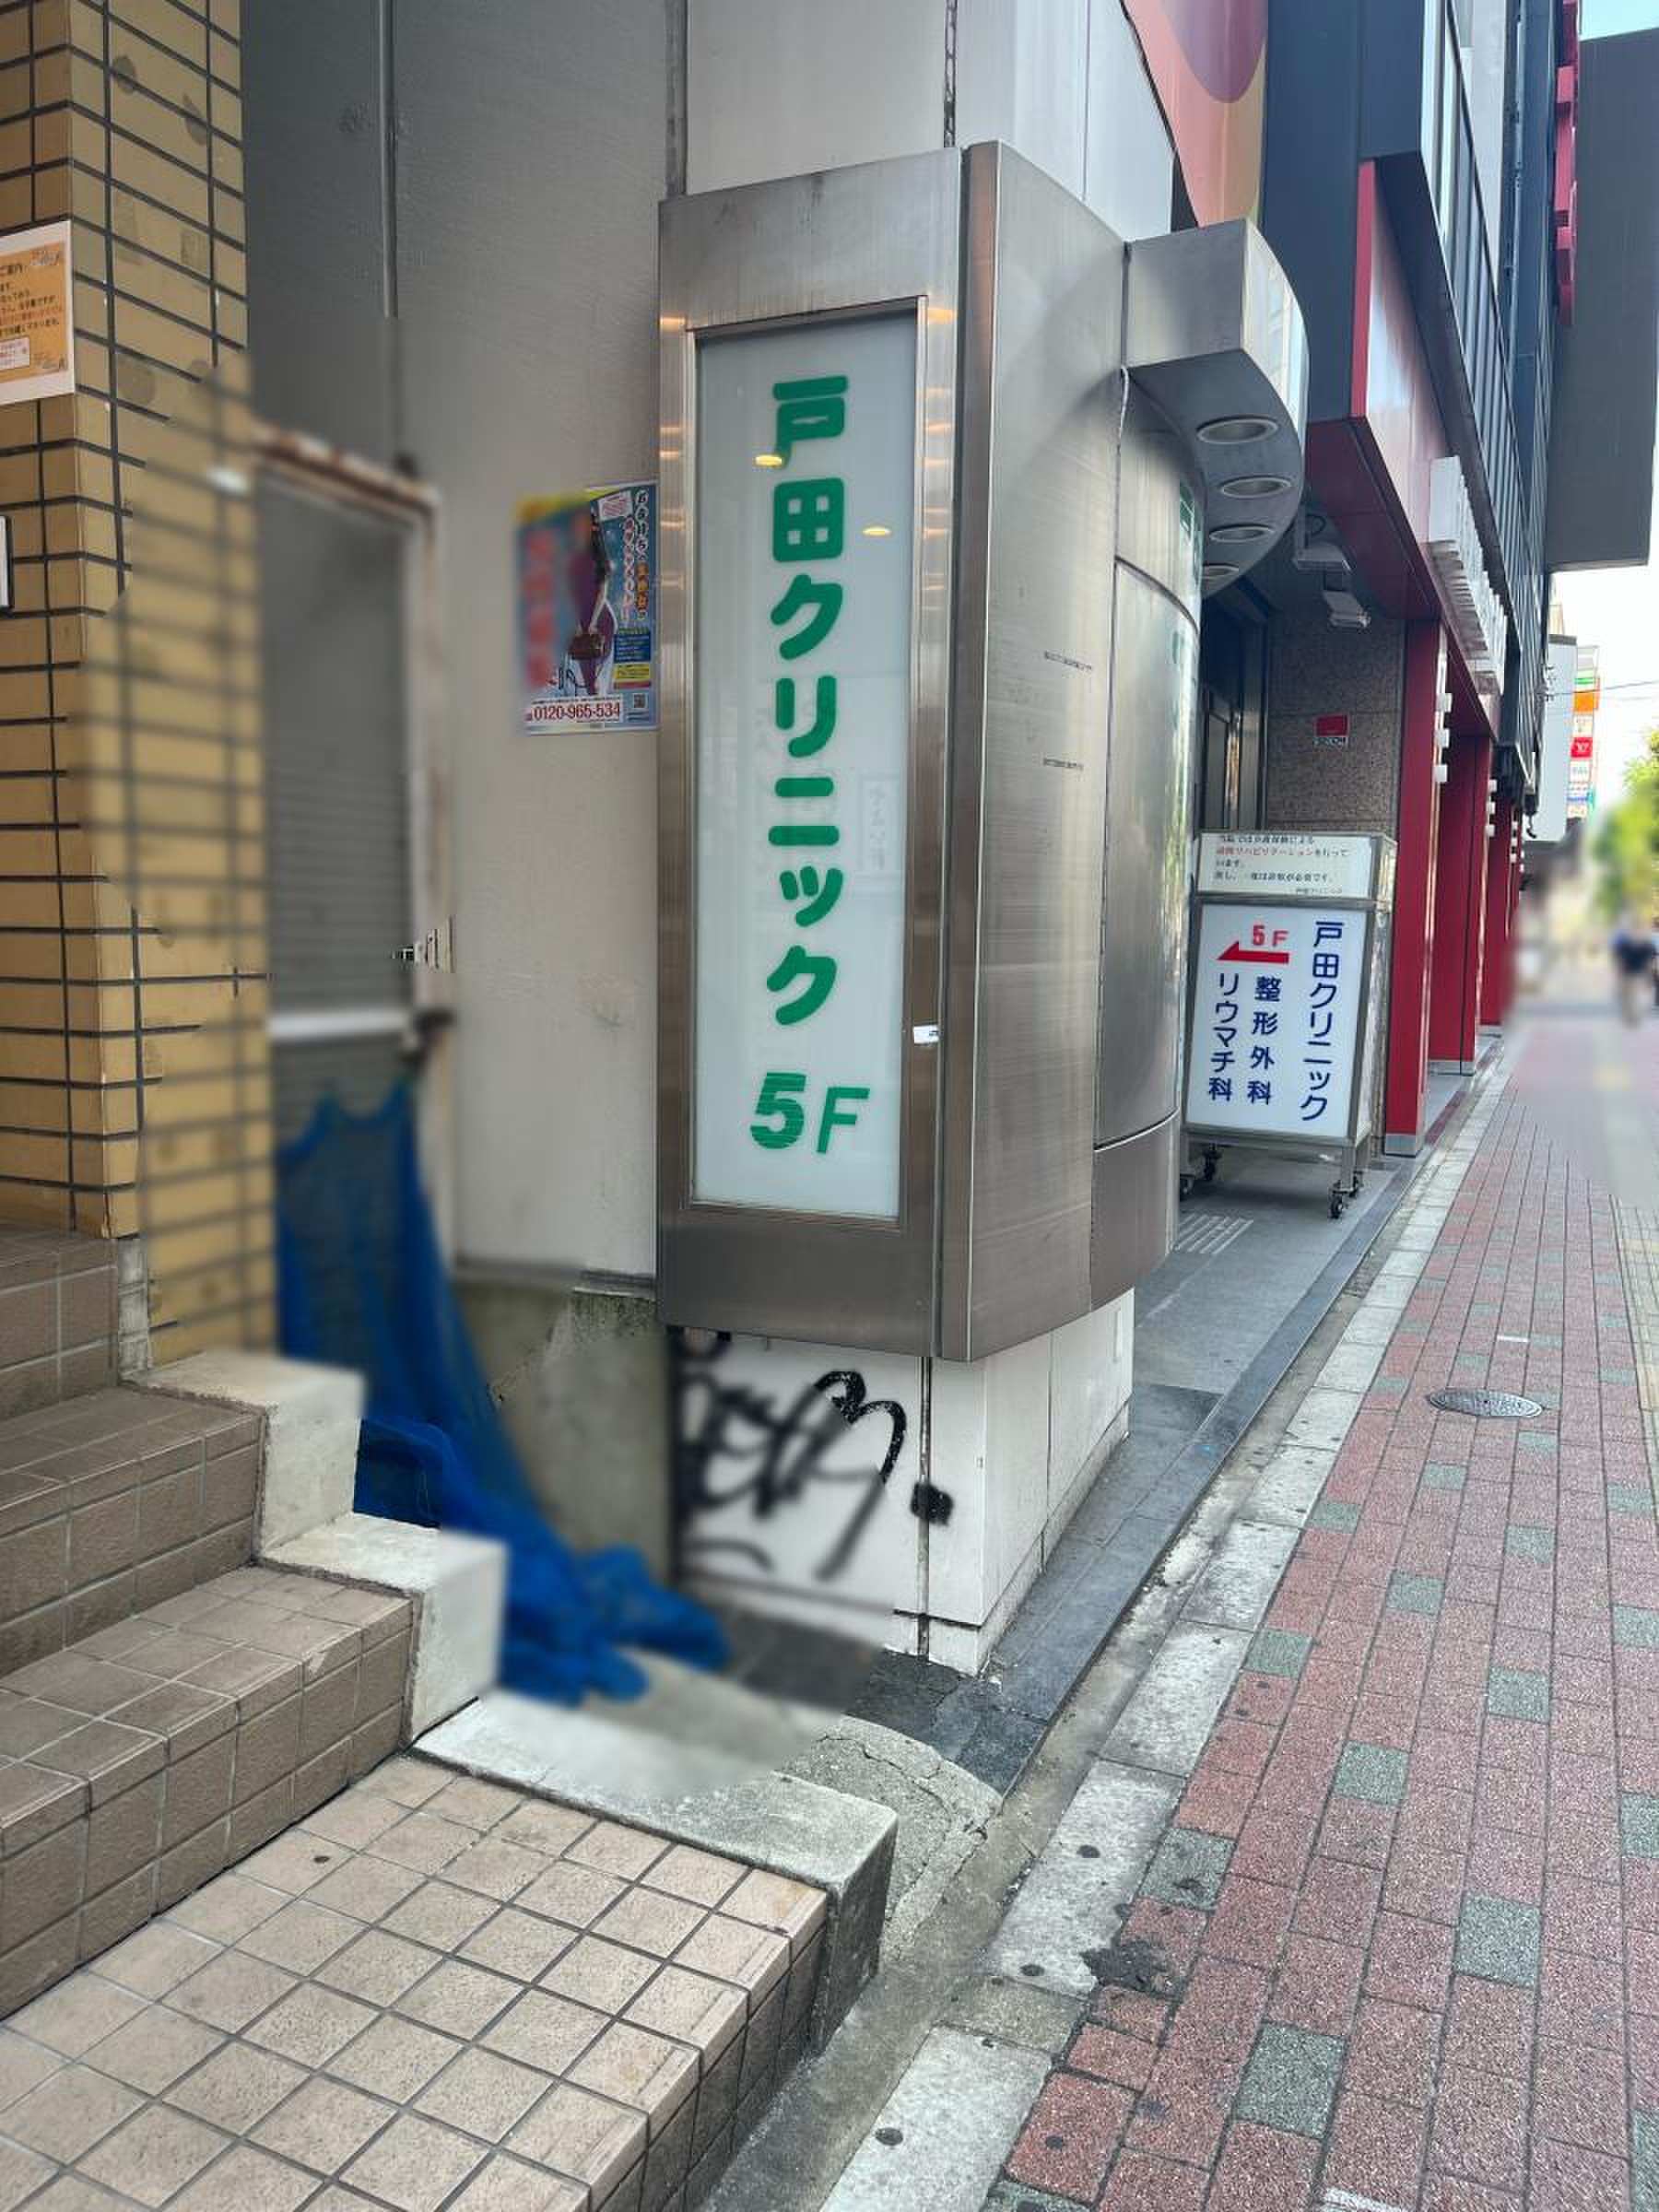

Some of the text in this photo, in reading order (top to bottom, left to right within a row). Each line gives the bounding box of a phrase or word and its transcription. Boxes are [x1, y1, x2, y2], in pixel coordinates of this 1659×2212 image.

[767, 376, 847, 1025] 戸田クリニック
[1252, 924, 1290, 947] 5F
[1207, 973, 1239, 1101] リウマチ科
[1247, 976, 1281, 1105] 整形外科
[1300, 922, 1345, 1121] 戸田クリニック
[751, 1072, 871, 1154] 5F
